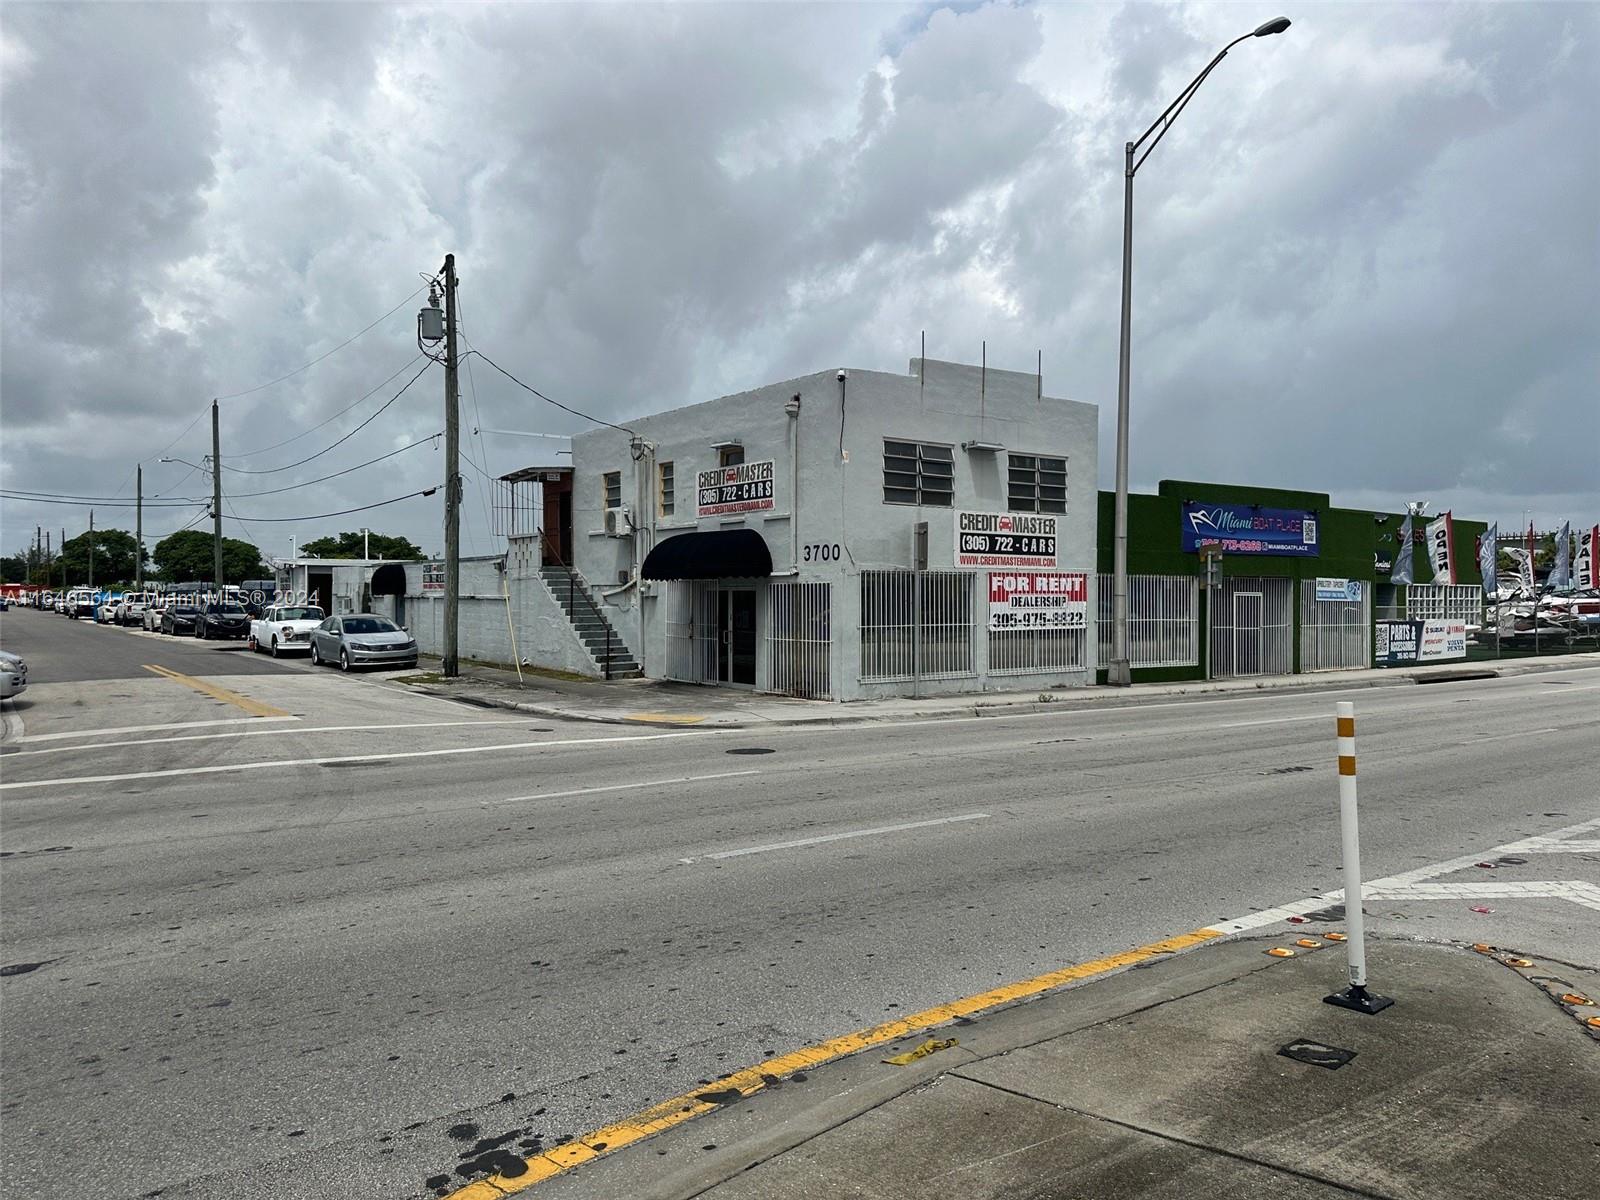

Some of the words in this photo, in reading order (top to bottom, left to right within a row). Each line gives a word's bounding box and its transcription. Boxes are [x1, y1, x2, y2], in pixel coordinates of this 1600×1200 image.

[699, 468, 726, 488] CREDIT
[736, 462, 773, 483] MASTER
[700, 489, 719, 505] (305)
[960, 513, 999, 532] CREDIT
[1012, 516, 1056, 535] MASTER
[1215, 508, 1253, 533] Miami
[1253, 516, 1274, 531] BOAT
[962, 535, 989, 551] (305)
[803, 544, 841, 562] 3700
[960, 555, 1056, 568] WWW.CREDITMASTERMIAMI.COM
[992, 577, 1029, 591] FOR
[1036, 577, 1083, 592] RENT
[1011, 596, 1067, 607] DEALERSHIP
[1391, 624, 1410, 640] PARTS
[1411, 625, 1416, 640] &
